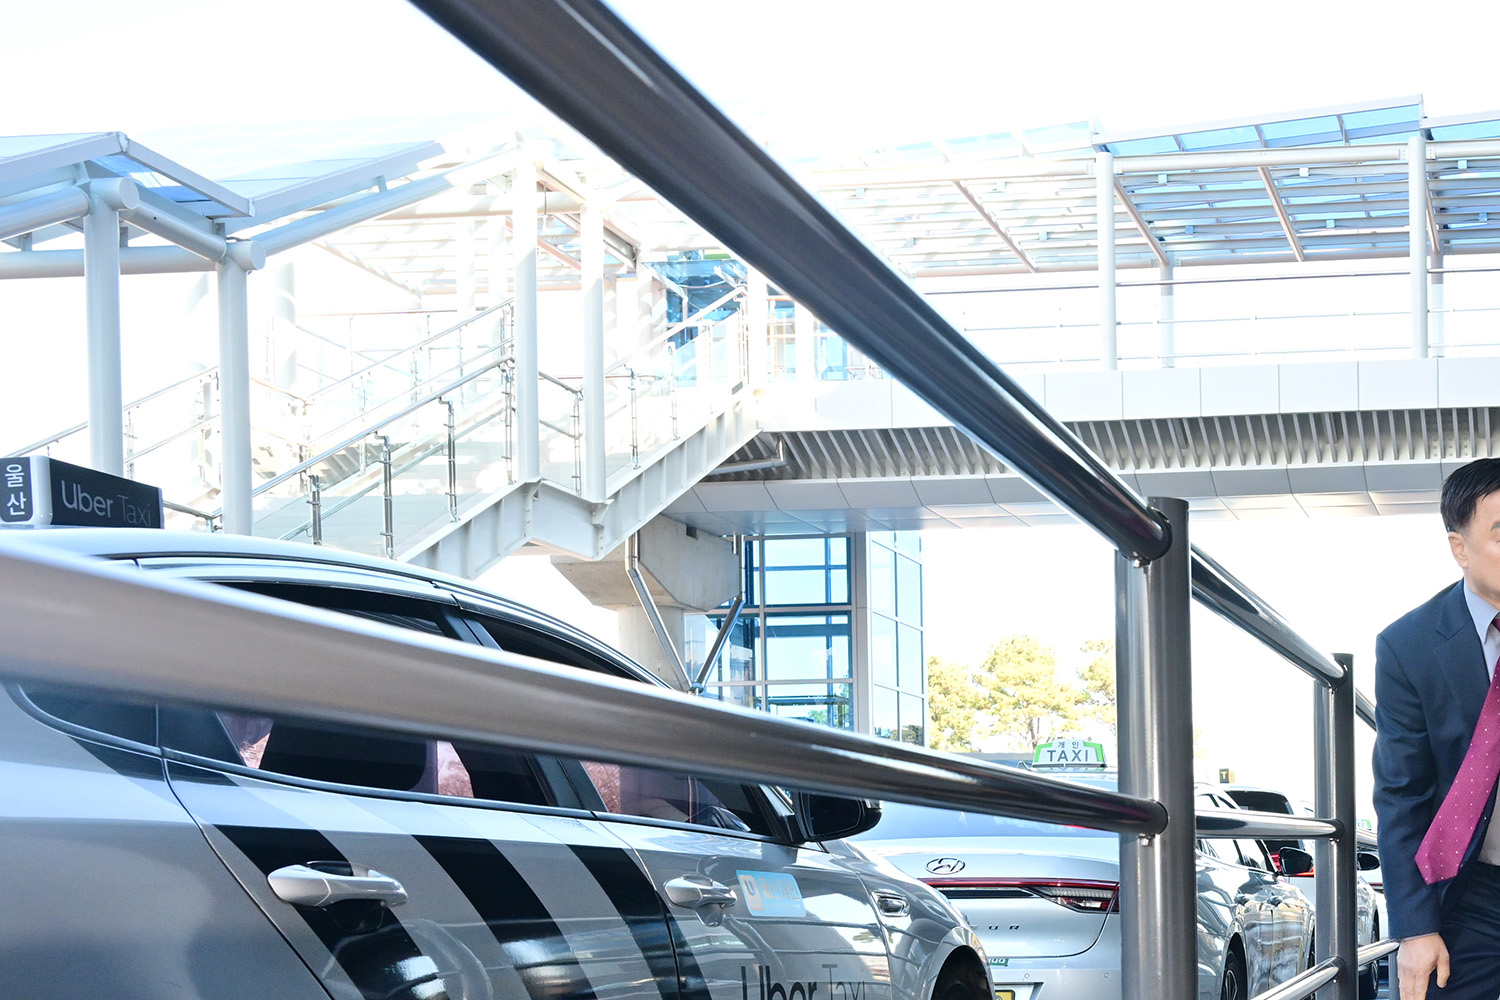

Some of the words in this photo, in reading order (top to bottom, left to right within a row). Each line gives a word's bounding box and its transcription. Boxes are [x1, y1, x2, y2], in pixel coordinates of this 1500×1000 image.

[5, 464, 27, 516] 울산
[61, 480, 113, 517] Uber
[117, 494, 151, 527] Taxi
[1047, 750, 1088, 762] TAXI
[1058, 741, 1079, 749] 개인
